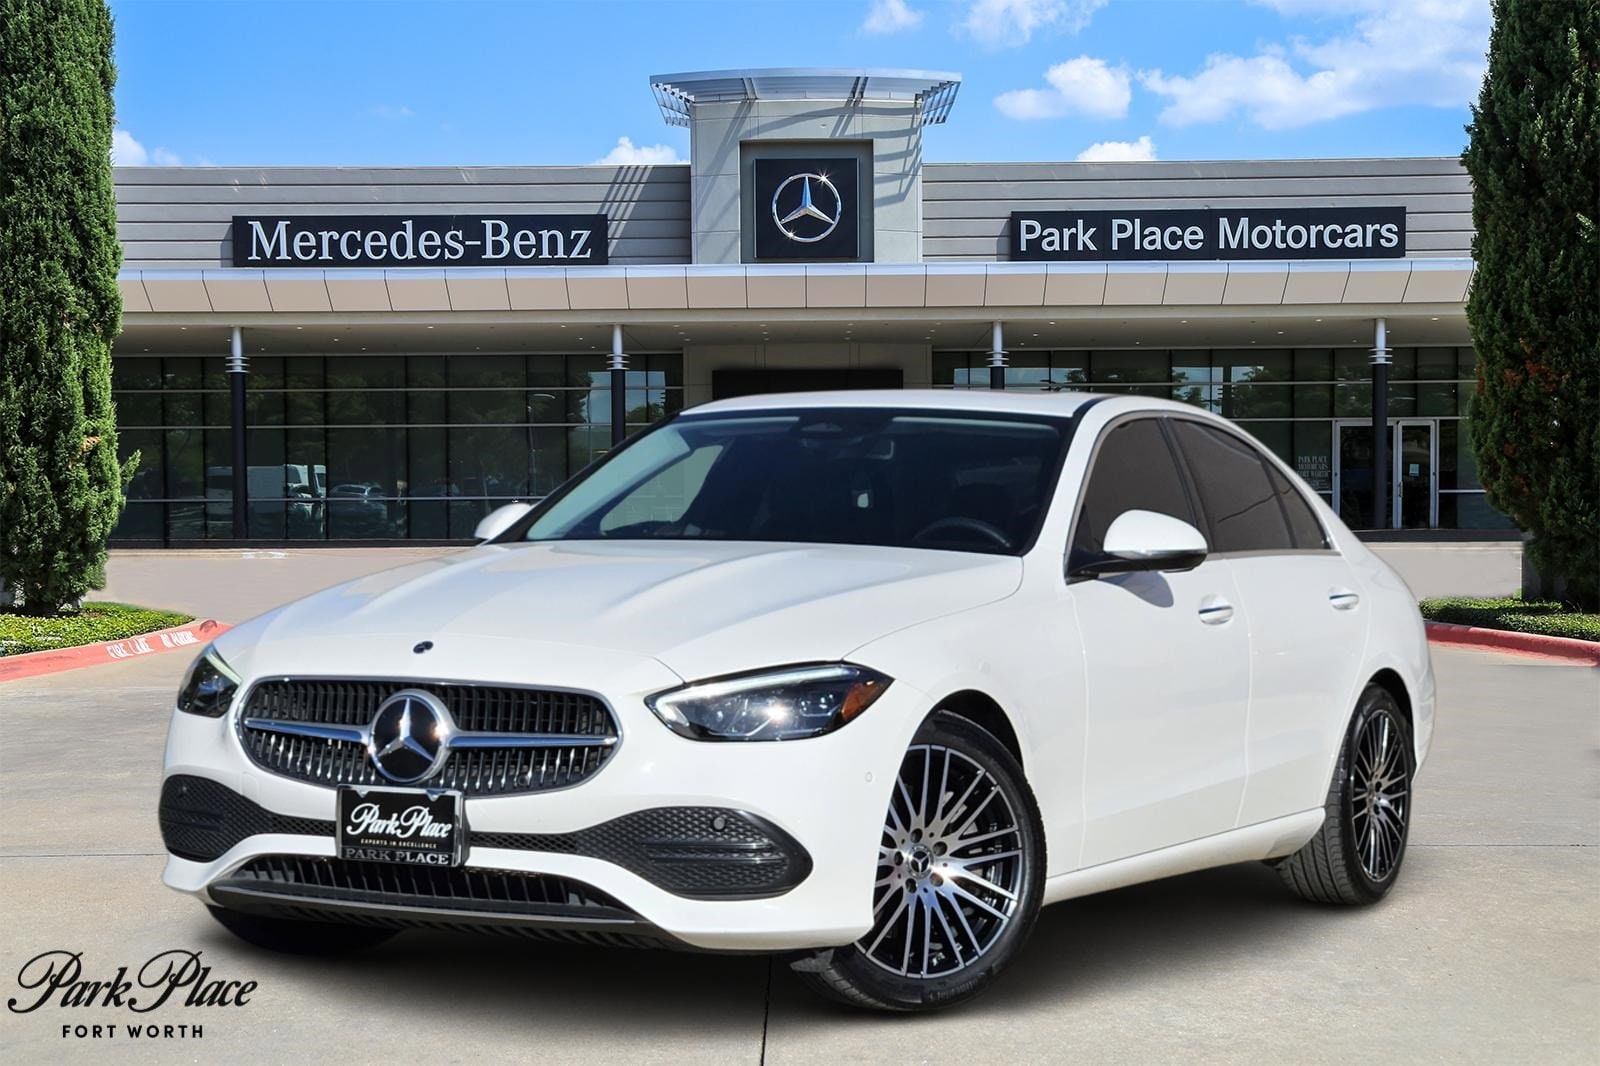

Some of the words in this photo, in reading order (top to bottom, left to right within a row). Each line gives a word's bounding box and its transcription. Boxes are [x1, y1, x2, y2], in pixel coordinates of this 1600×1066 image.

[247, 219, 593, 261] Mercedes-Benz
[1019, 218, 1098, 252] Park
[1111, 217, 1205, 251] Place
[1218, 216, 1399, 250] Motorcars
[346, 802, 399, 835] Park
[396, 805, 453, 838] Place
[345, 848, 391, 861] PARK
[395, 851, 449, 865] PLACE
